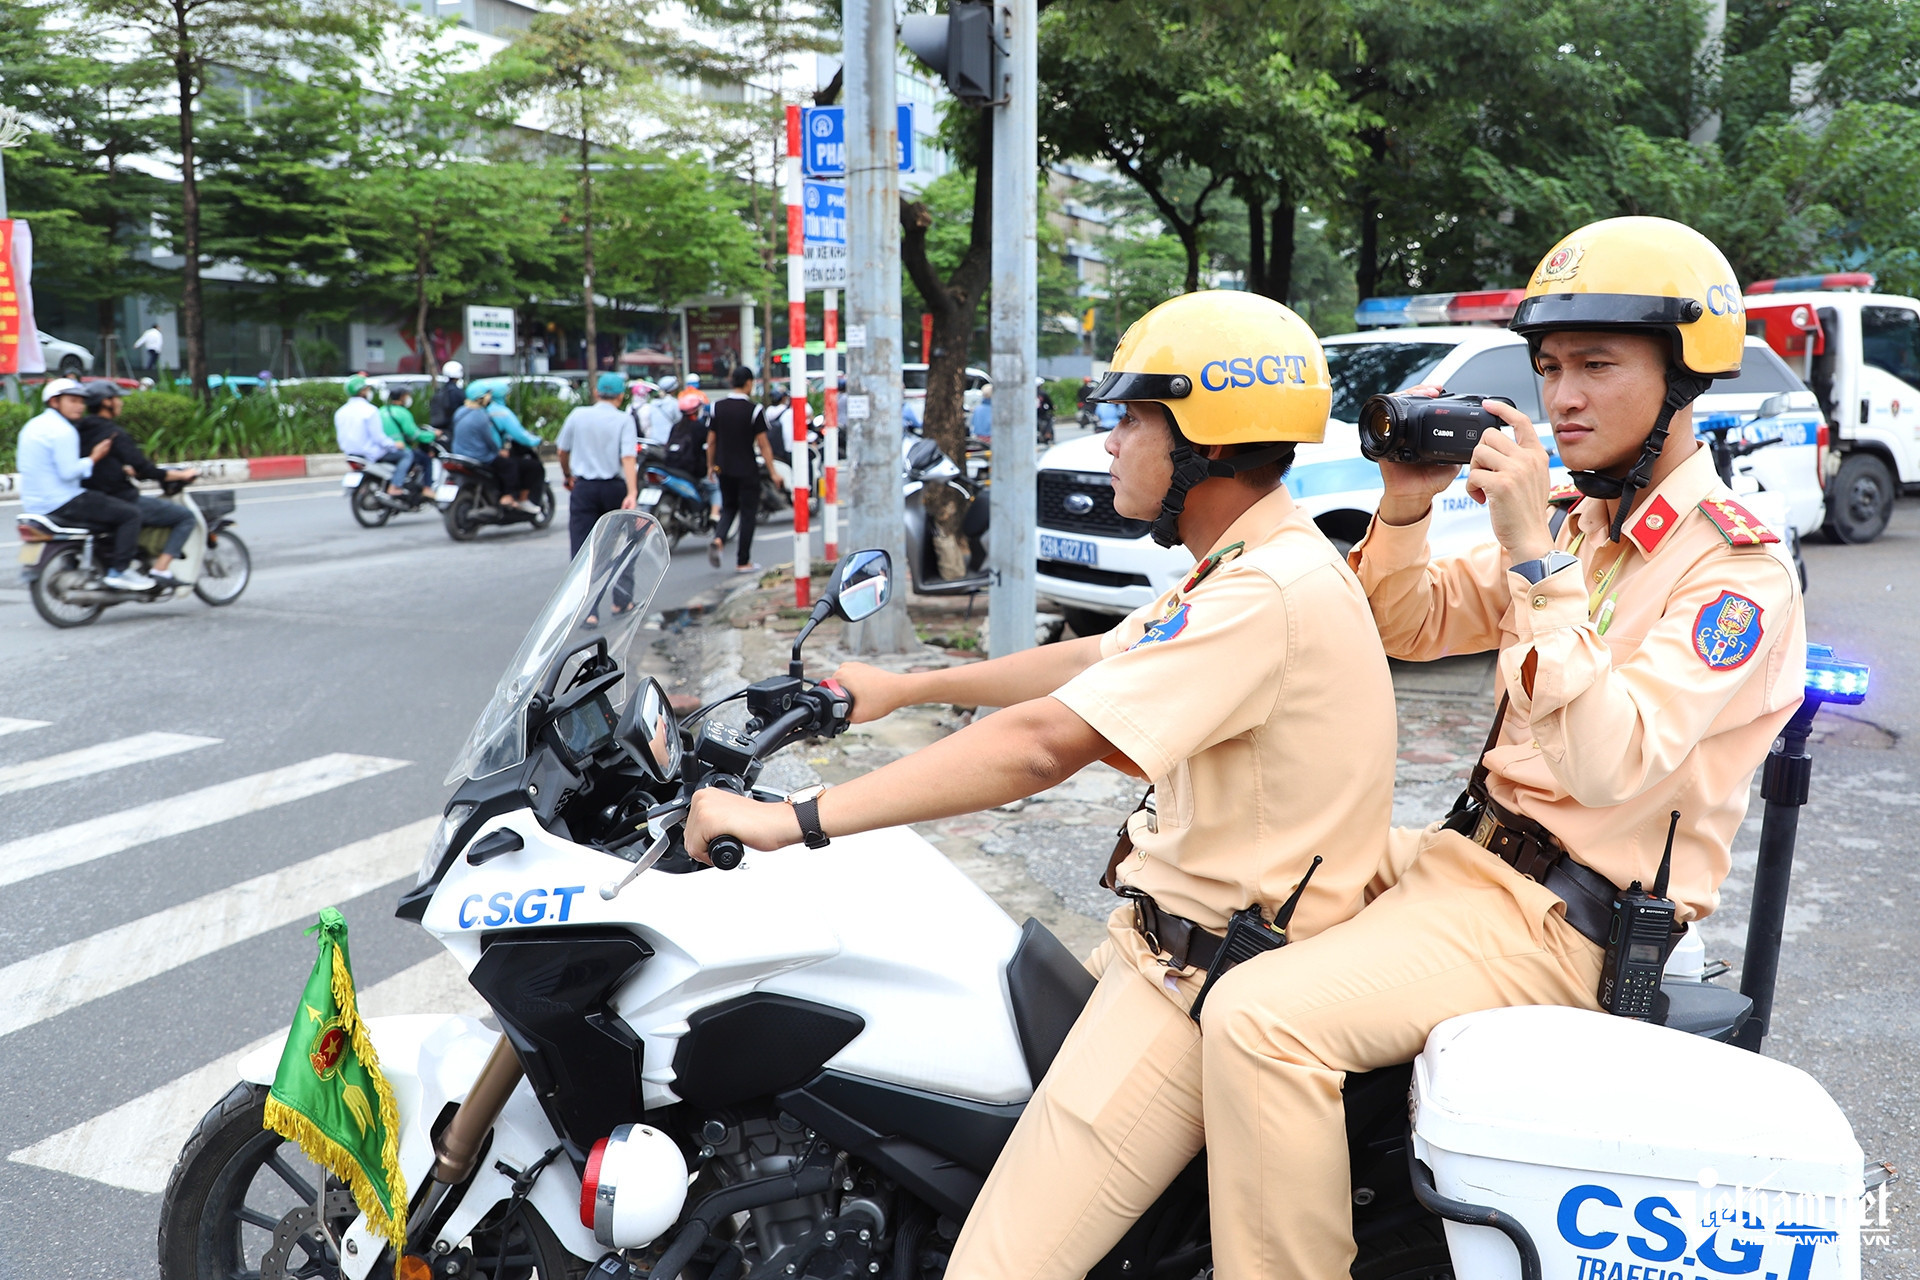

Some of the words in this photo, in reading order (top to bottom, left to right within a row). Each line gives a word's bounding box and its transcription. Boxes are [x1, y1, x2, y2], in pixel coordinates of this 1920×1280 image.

[816, 142, 846, 169] PHẠ
[1707, 284, 1745, 316] CS
[1201, 355, 1307, 391] CSGT
[1433, 429, 1454, 437] Canon
[1443, 497, 1488, 512] TRAFF
[1701, 627, 1748, 653] CSGT
[458, 885, 586, 929] C.S.G.T
